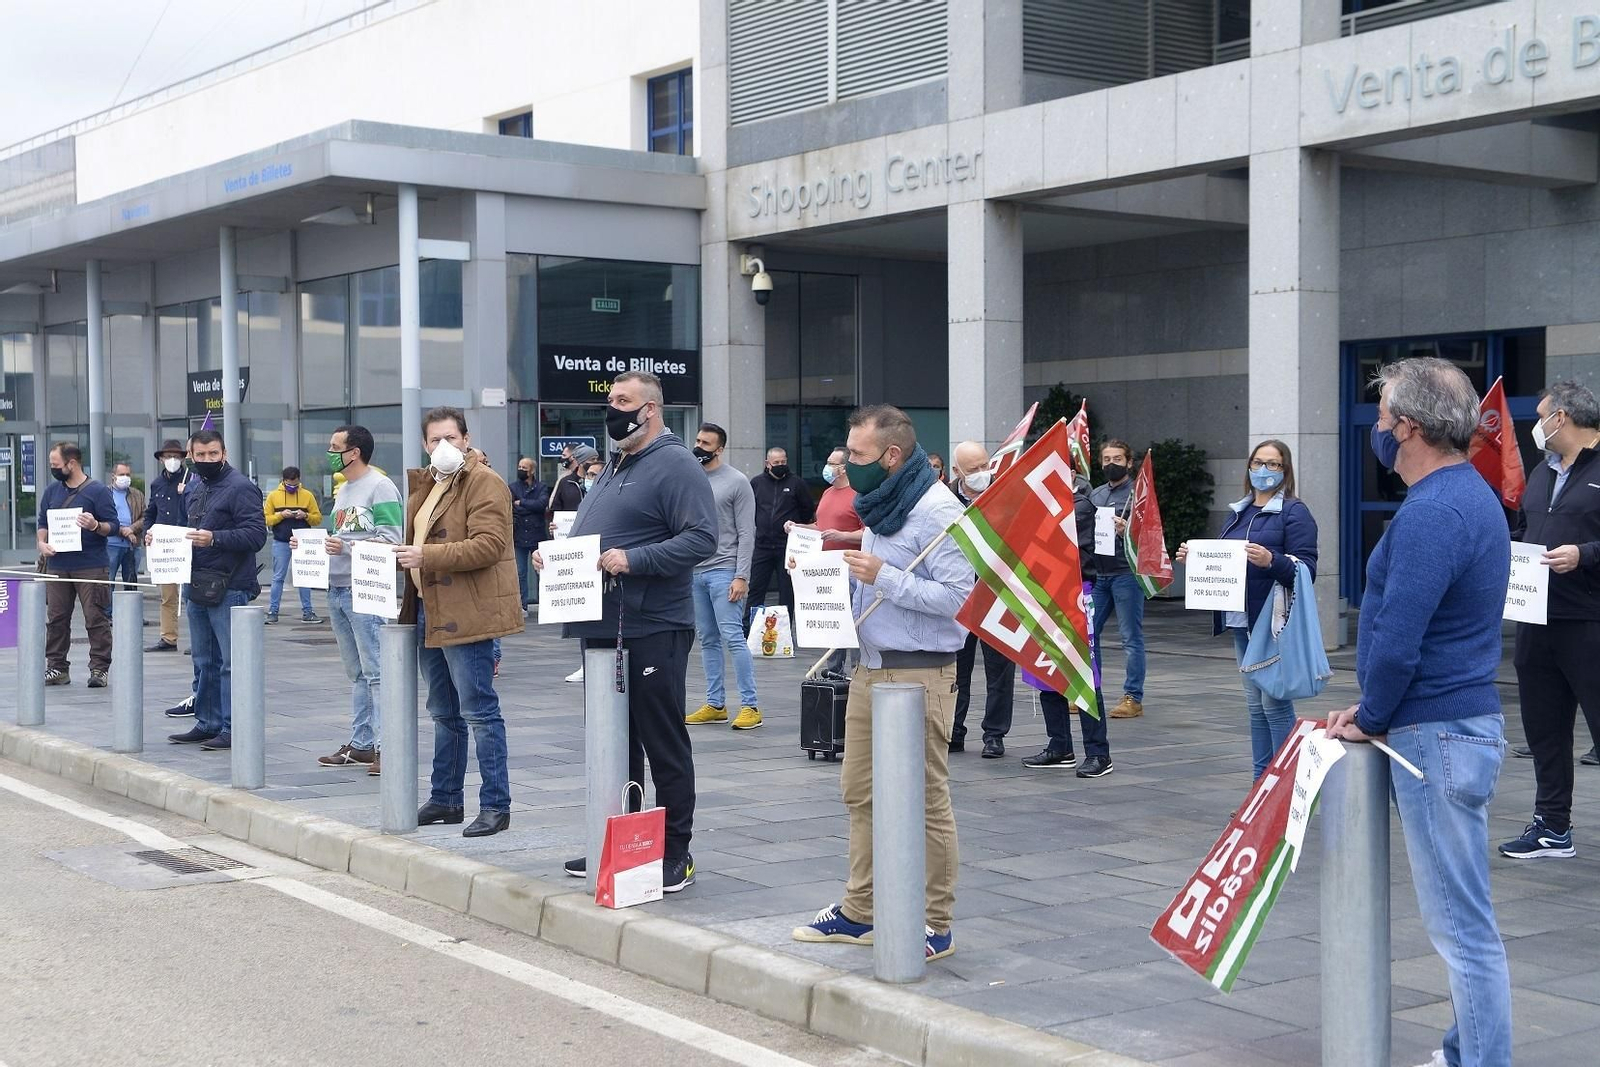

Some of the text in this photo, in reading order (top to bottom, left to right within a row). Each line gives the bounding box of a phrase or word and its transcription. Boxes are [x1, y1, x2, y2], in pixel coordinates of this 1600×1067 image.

[1324, 53, 1462, 114] Venta
[1483, 24, 1548, 86] de
[224, 163, 293, 193] Venta de Billetes
[750, 147, 983, 219] Shopping Center
[597, 301, 617, 310] SALIDA
[554, 355, 687, 374] Venta de Billetes
[192, 380, 211, 393] Venta
[212, 378, 221, 391] de
[548, 551, 584, 562] TRABAJADORES
[557, 568, 574, 577] ARMAS
[802, 567, 841, 577] TRABAJADORES
[1205, 589, 1213, 597] SU
[551, 598, 560, 607] POR
[799, 602, 846, 611] TRANSMEDITERRANEA
[806, 620, 816, 628] POR
[816, 620, 824, 629] SU
